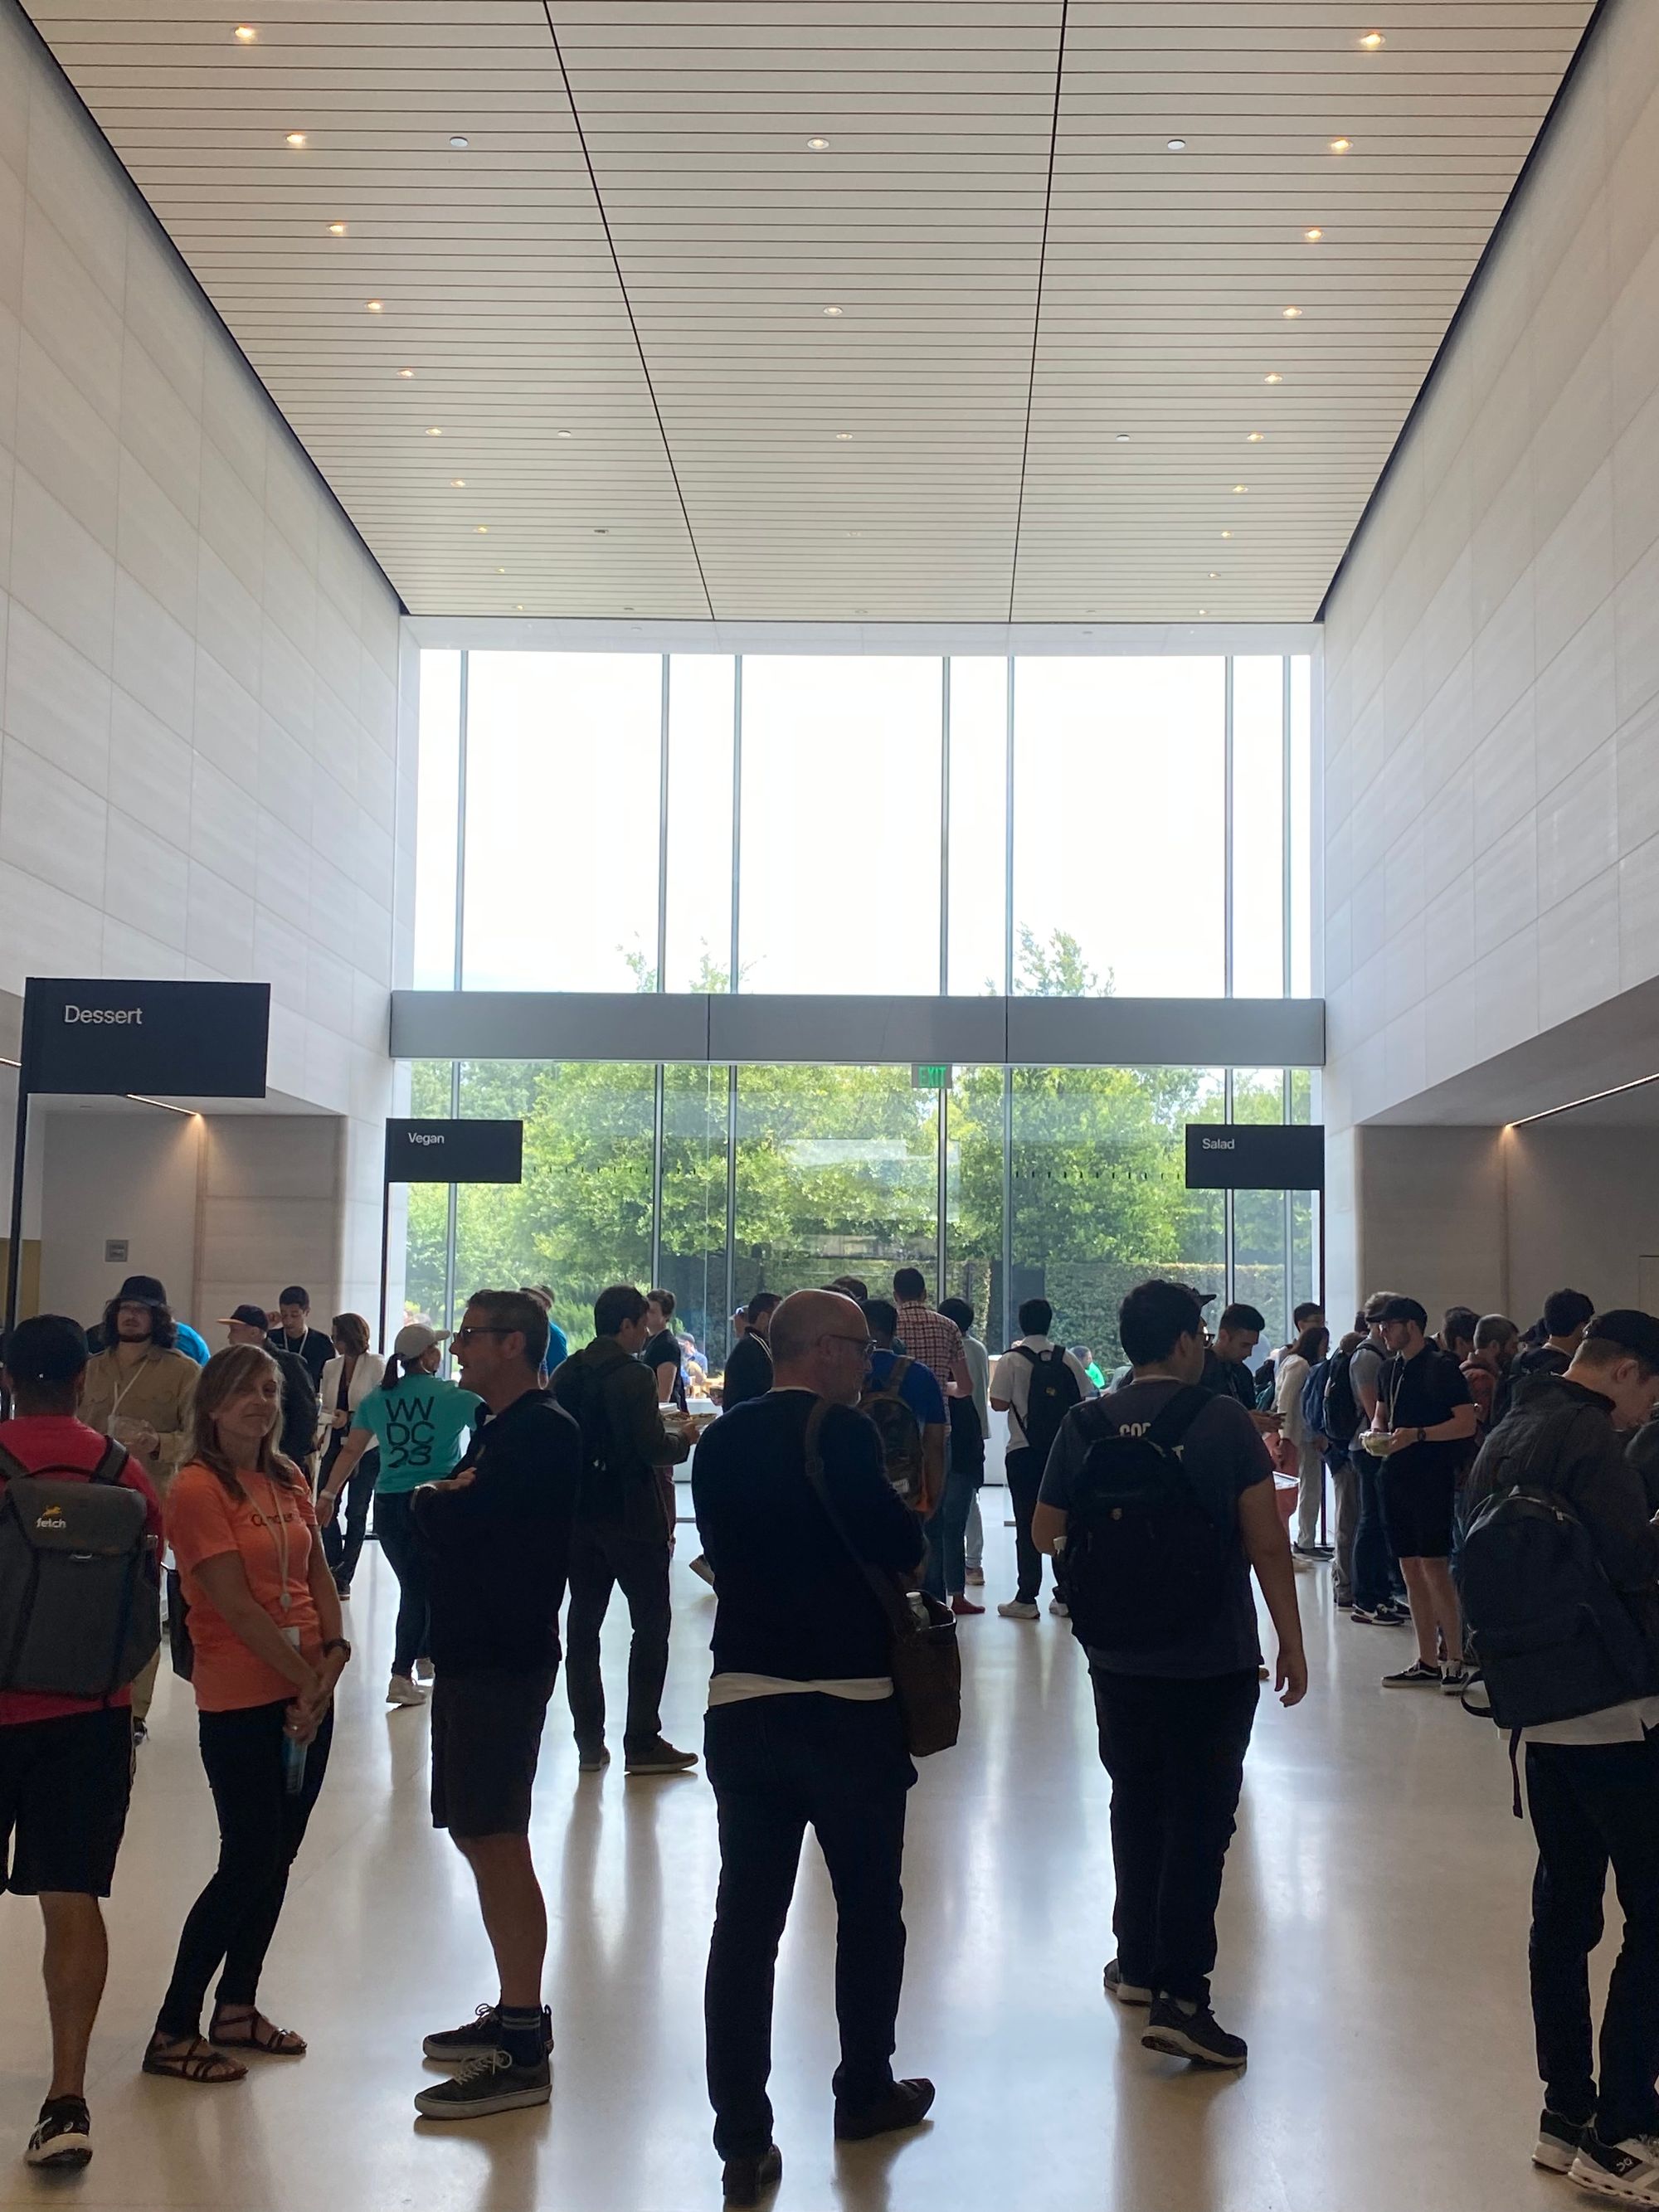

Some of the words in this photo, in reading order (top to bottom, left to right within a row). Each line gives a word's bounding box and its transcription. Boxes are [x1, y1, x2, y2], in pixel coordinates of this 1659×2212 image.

[64, 1004, 144, 1024] Dessert
[918, 1066, 946, 1087] EXIT
[407, 1131, 445, 1145] Vegan
[1202, 1137, 1235, 1150] Salad
[387, 1421, 435, 1446] DC
[36, 1517, 67, 1529] fetch
